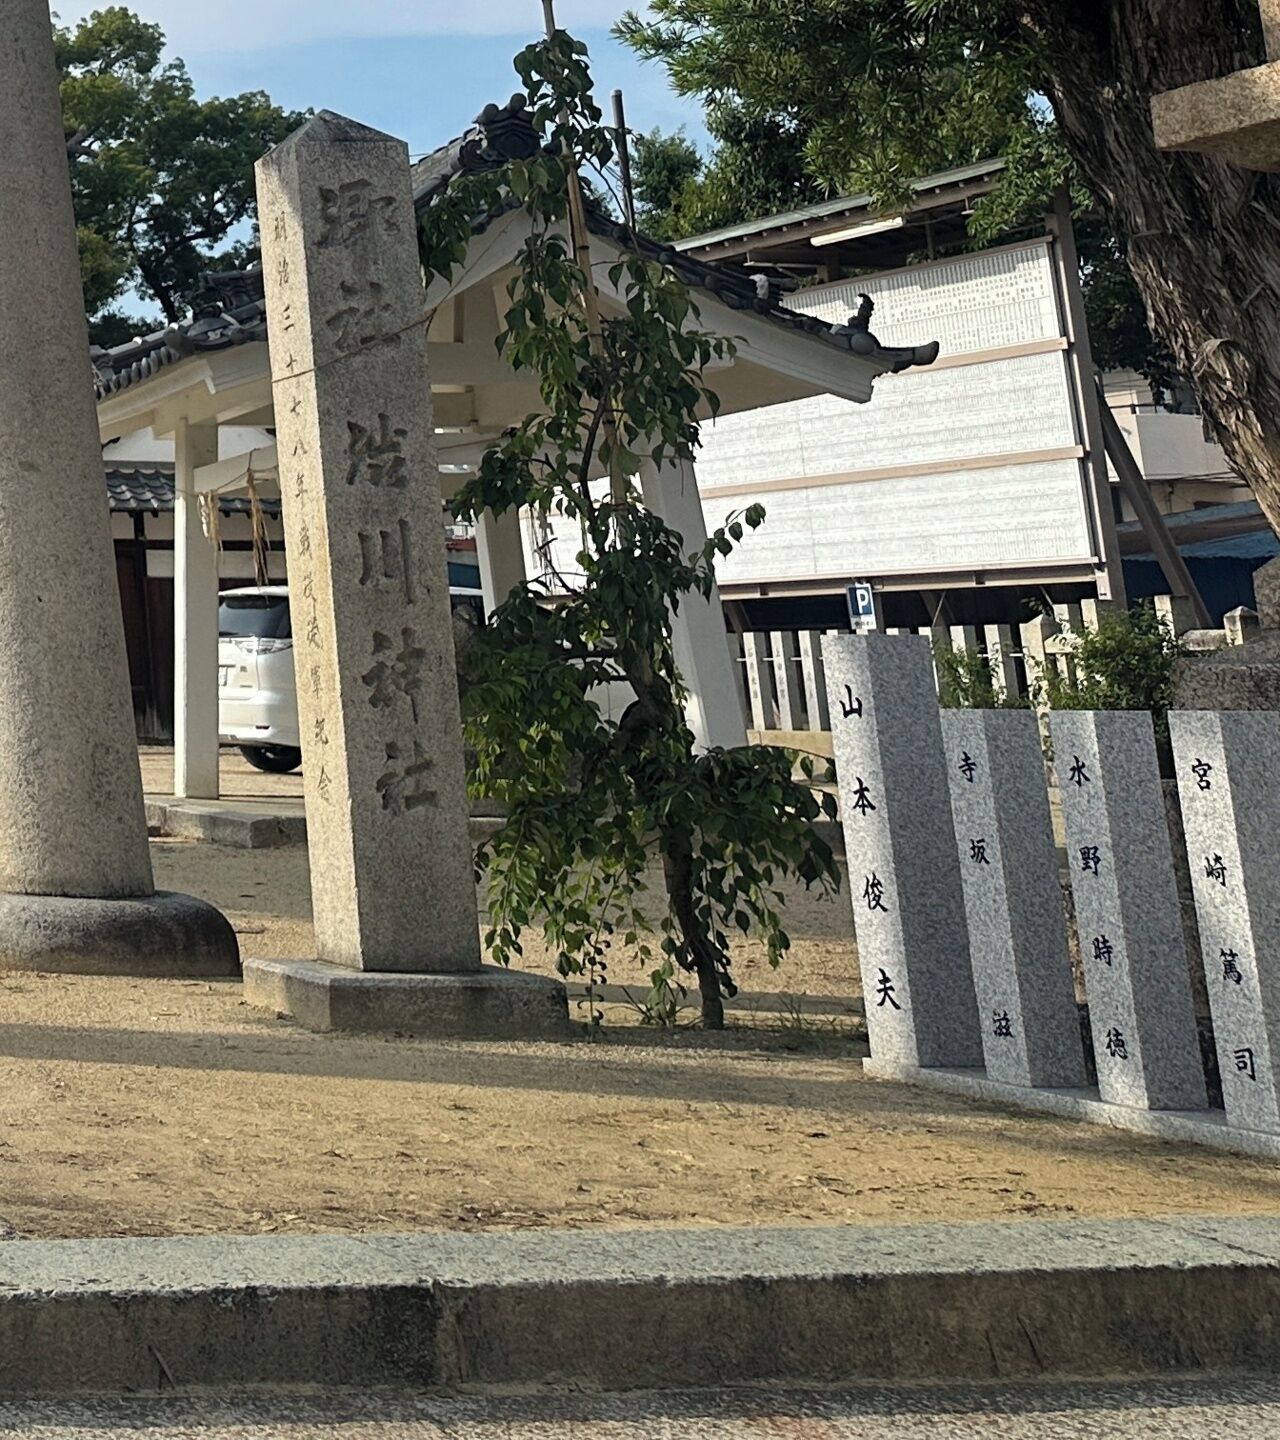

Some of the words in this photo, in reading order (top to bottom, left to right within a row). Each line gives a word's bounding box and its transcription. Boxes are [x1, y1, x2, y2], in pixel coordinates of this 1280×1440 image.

[855, 588, 870, 615] P
[838, 683, 902, 1011] 山本俊夫
[957, 751, 1015, 1039] 寺坂滋
[1191, 757, 1257, 1083] 宮崎篤司
